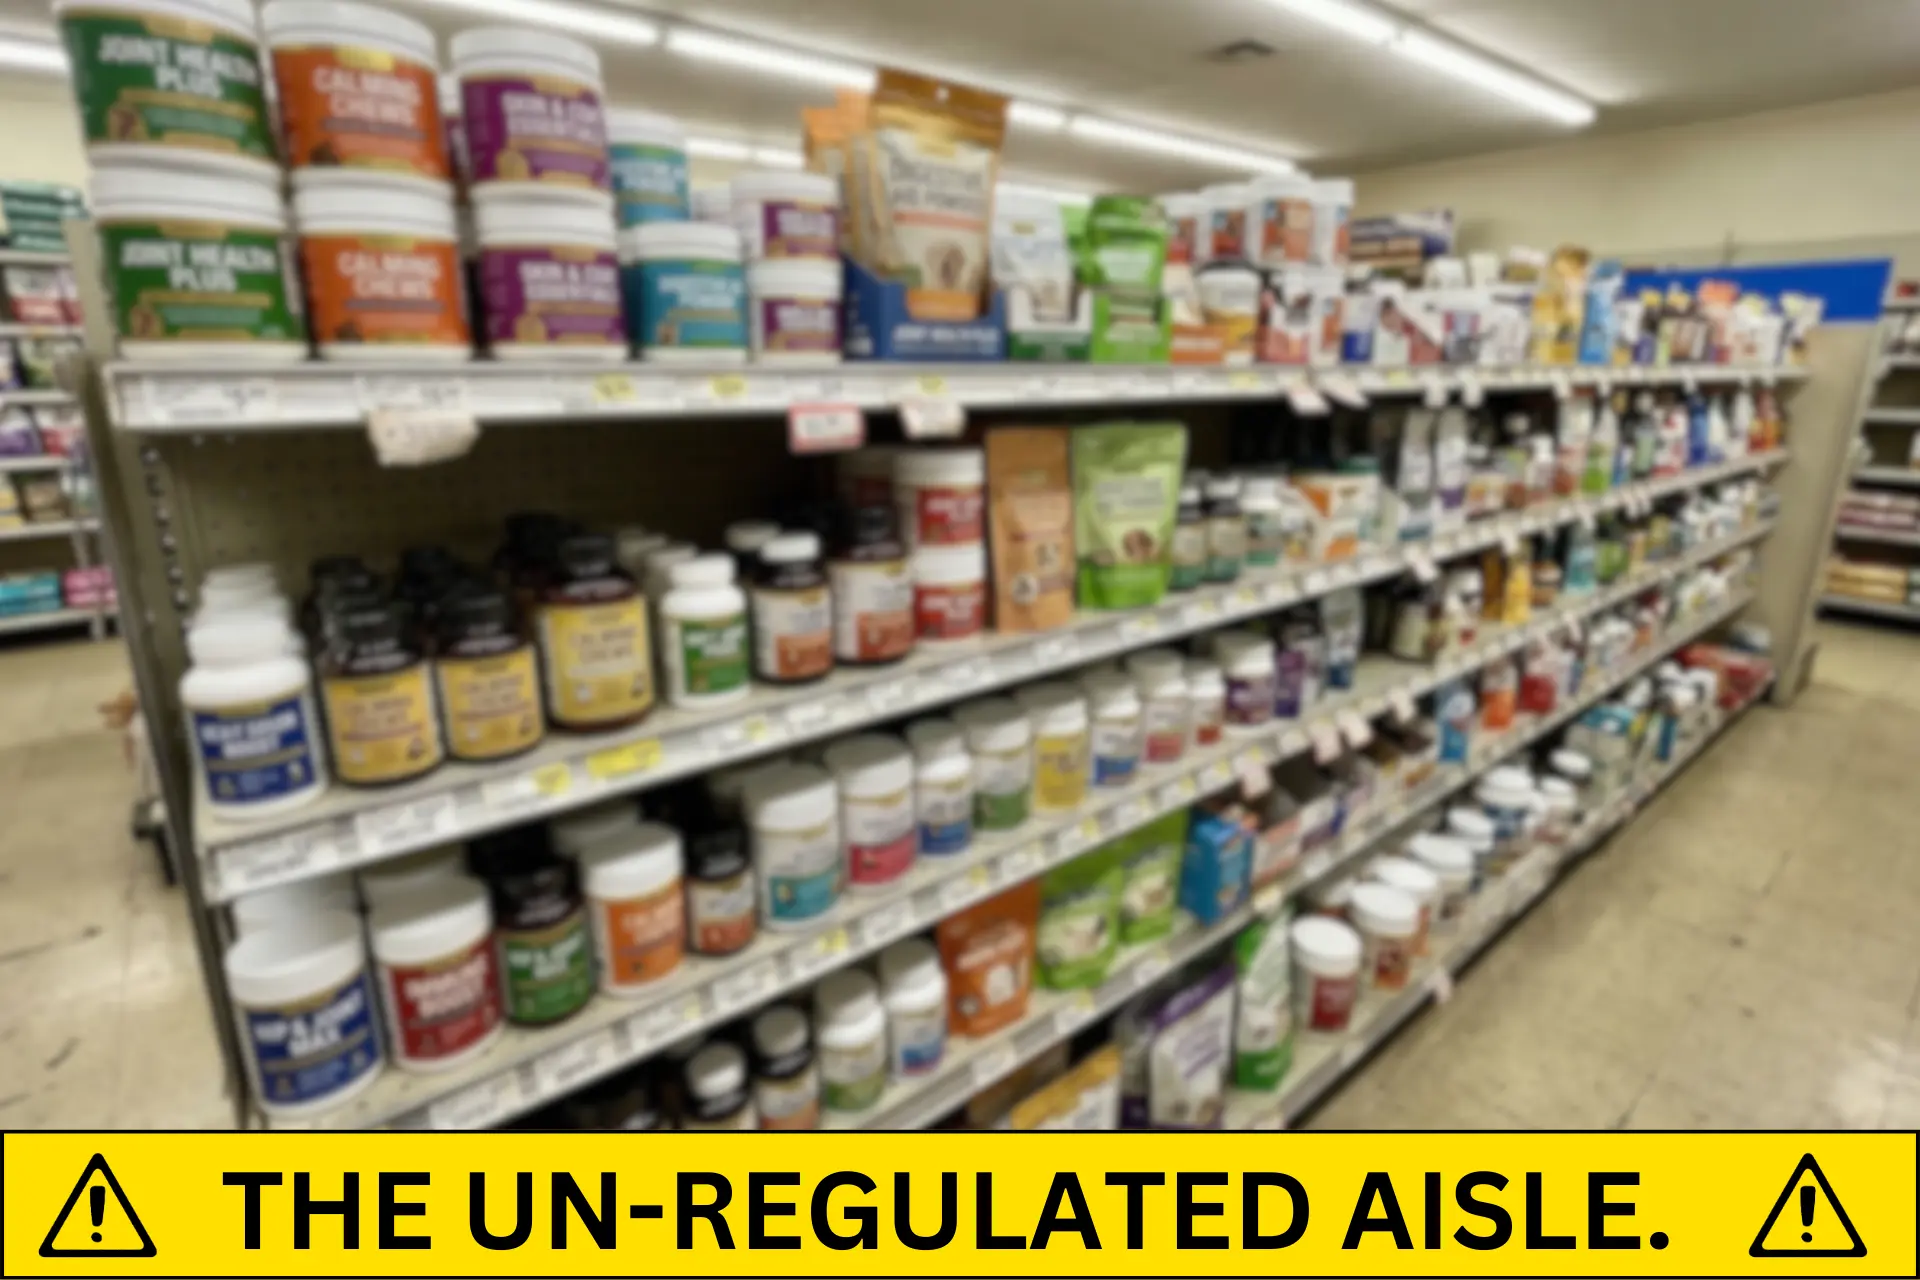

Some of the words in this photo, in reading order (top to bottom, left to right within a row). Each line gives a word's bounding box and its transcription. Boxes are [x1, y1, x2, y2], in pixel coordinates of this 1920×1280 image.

[154, 64, 224, 99] PLUS
[311, 66, 422, 106] CALMING
[168, 266, 237, 292] PLUS
[337, 251, 442, 279] CALMING
